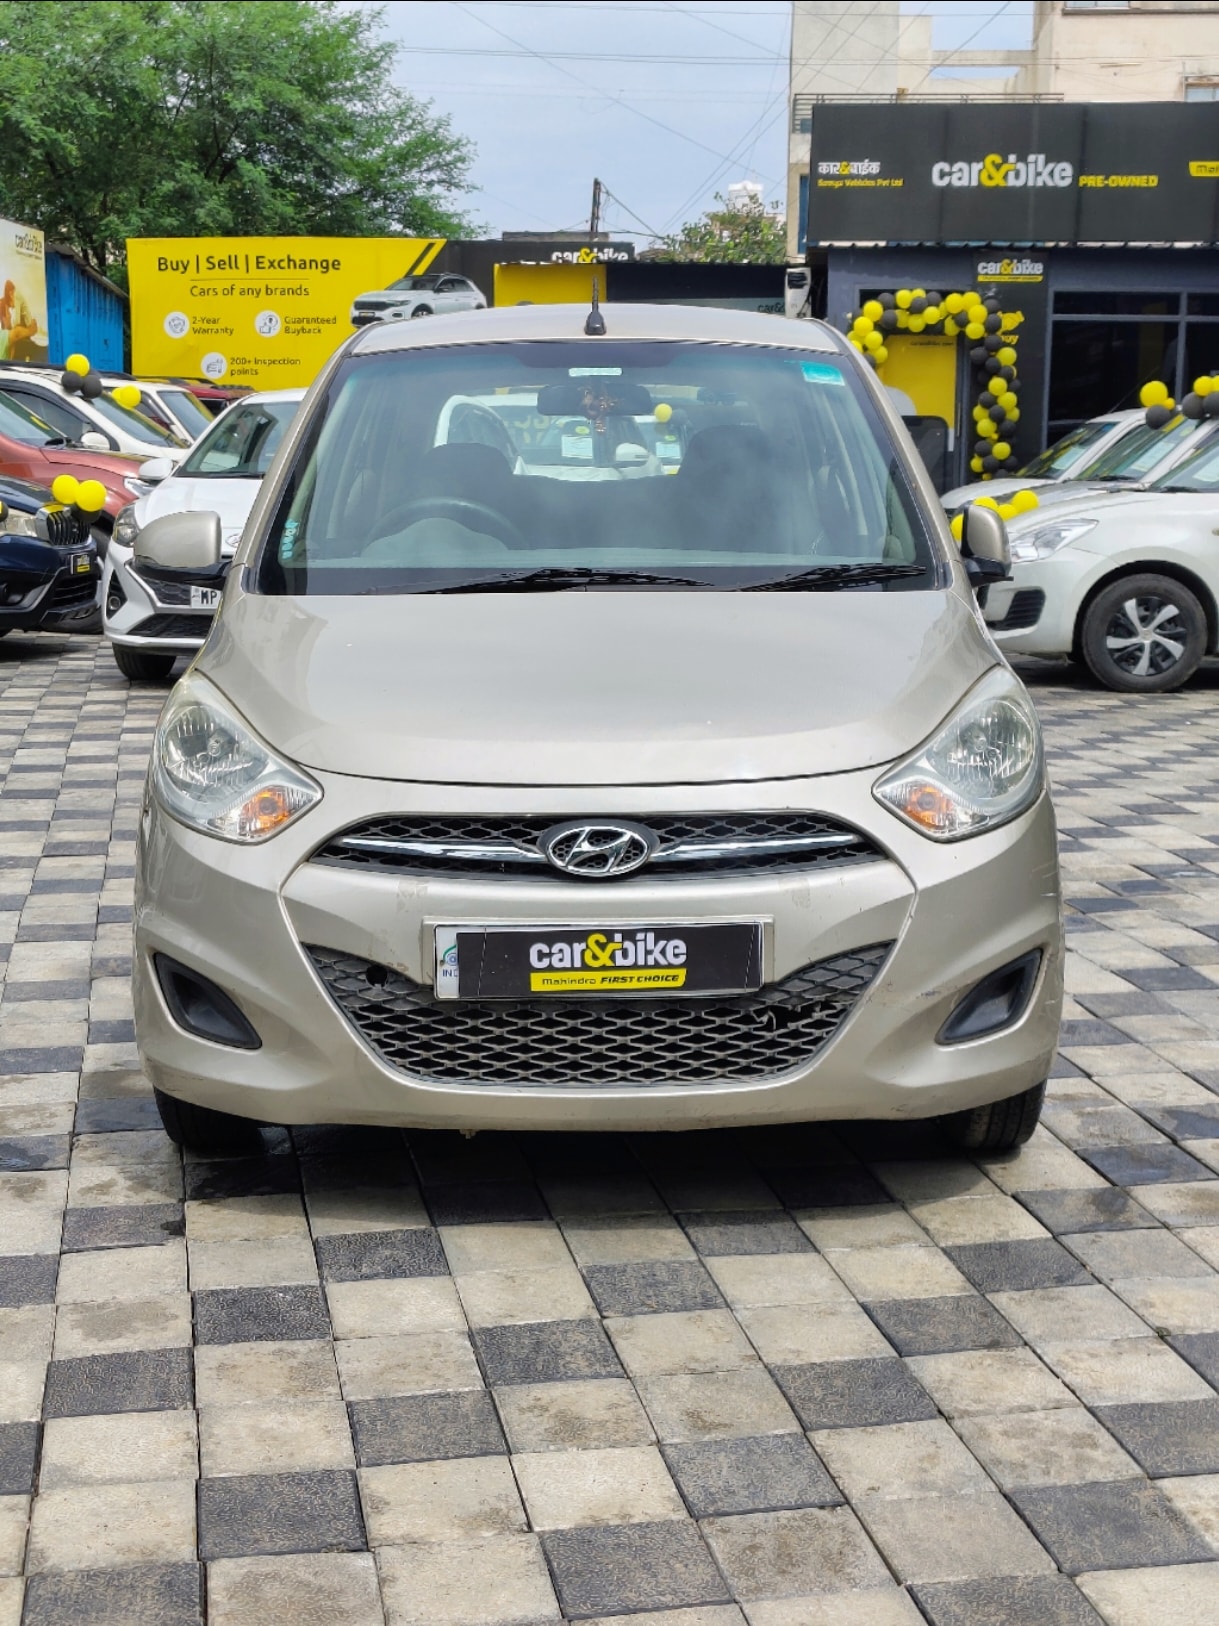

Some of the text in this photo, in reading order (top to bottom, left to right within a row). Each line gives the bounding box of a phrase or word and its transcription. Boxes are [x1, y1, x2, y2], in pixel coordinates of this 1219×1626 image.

[931, 153, 1159, 187] car&bike PRE-OWNED
[844, 178, 875, 187] Vehicles
[877, 178, 890, 187] Pvt
[891, 178, 904, 187] Ltd
[157, 256, 190, 274] Buy
[206, 255, 240, 271] Sell
[255, 255, 342, 274] Exchange
[977, 259, 1044, 275] car&bike
[190, 284, 310, 299] Cars of any brands
[192, 316, 221, 325] 2-Year
[284, 316, 337, 325] Guaranteed
[192, 327, 235, 336] Warranty
[284, 327, 322, 337] Buyback
[230, 357, 301, 367] 200+ Inspection
[230, 367, 259, 377] points
[201, 590, 218, 605] MP
[529, 932, 687, 969] car&bike
[542, 974, 680, 986] Mahindra FIRST CHOICE
